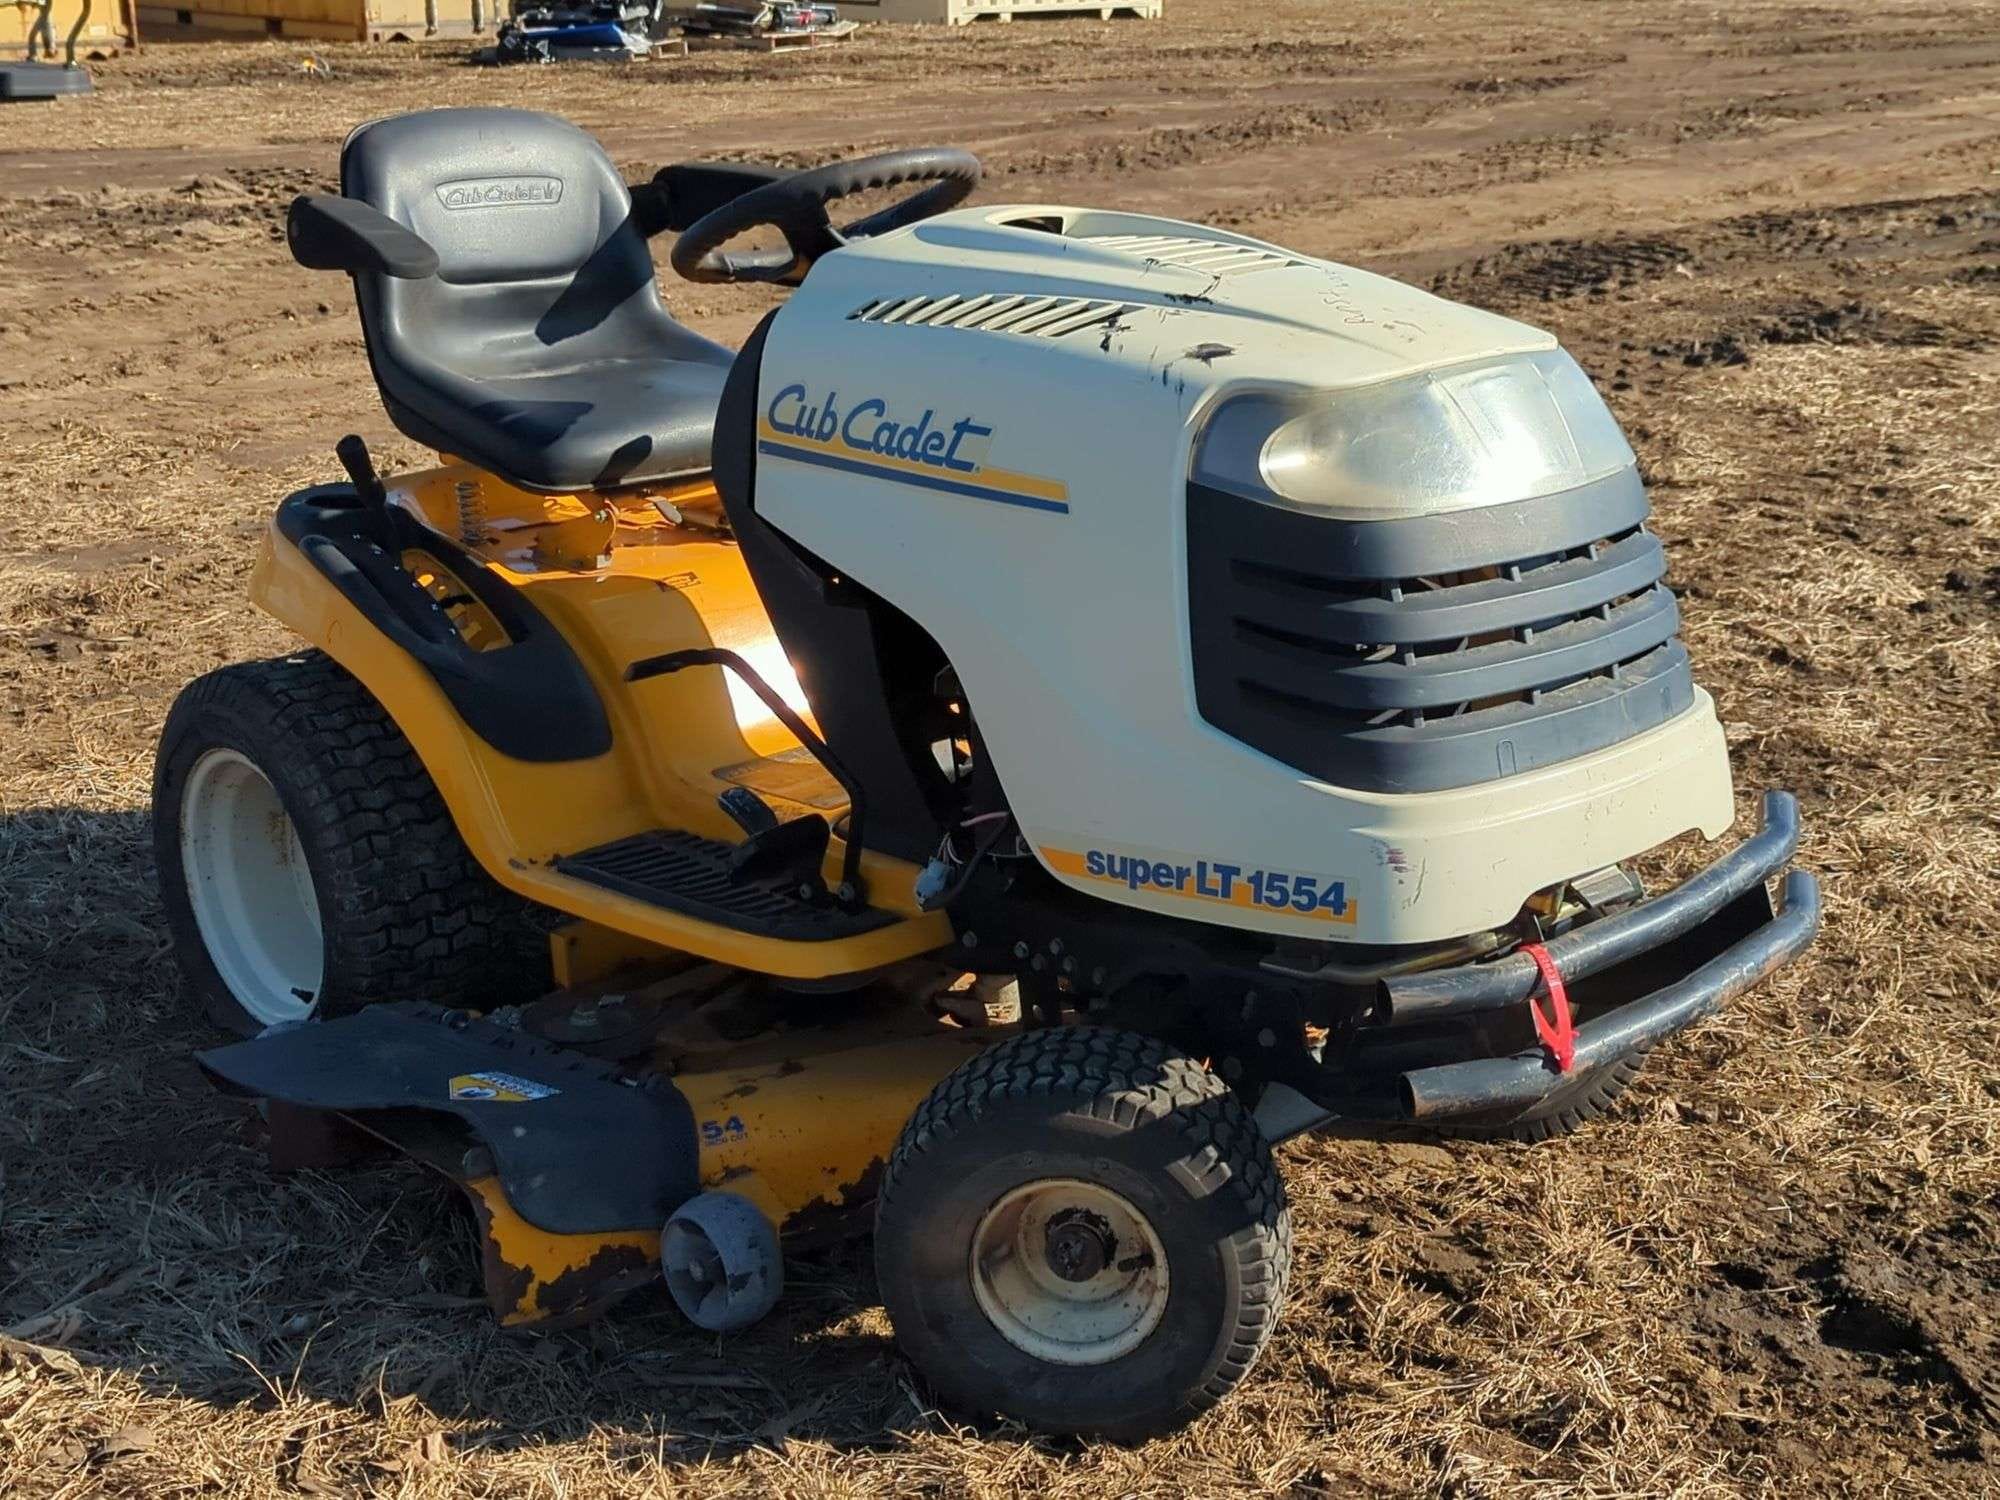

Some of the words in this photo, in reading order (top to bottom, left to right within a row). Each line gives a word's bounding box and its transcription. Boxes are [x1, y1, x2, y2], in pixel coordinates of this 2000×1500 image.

[768, 383, 838, 442] Cub
[842, 398, 992, 473] Cadet
[1247, 870, 1347, 916] 1554
[703, 1115, 745, 1139] 54
